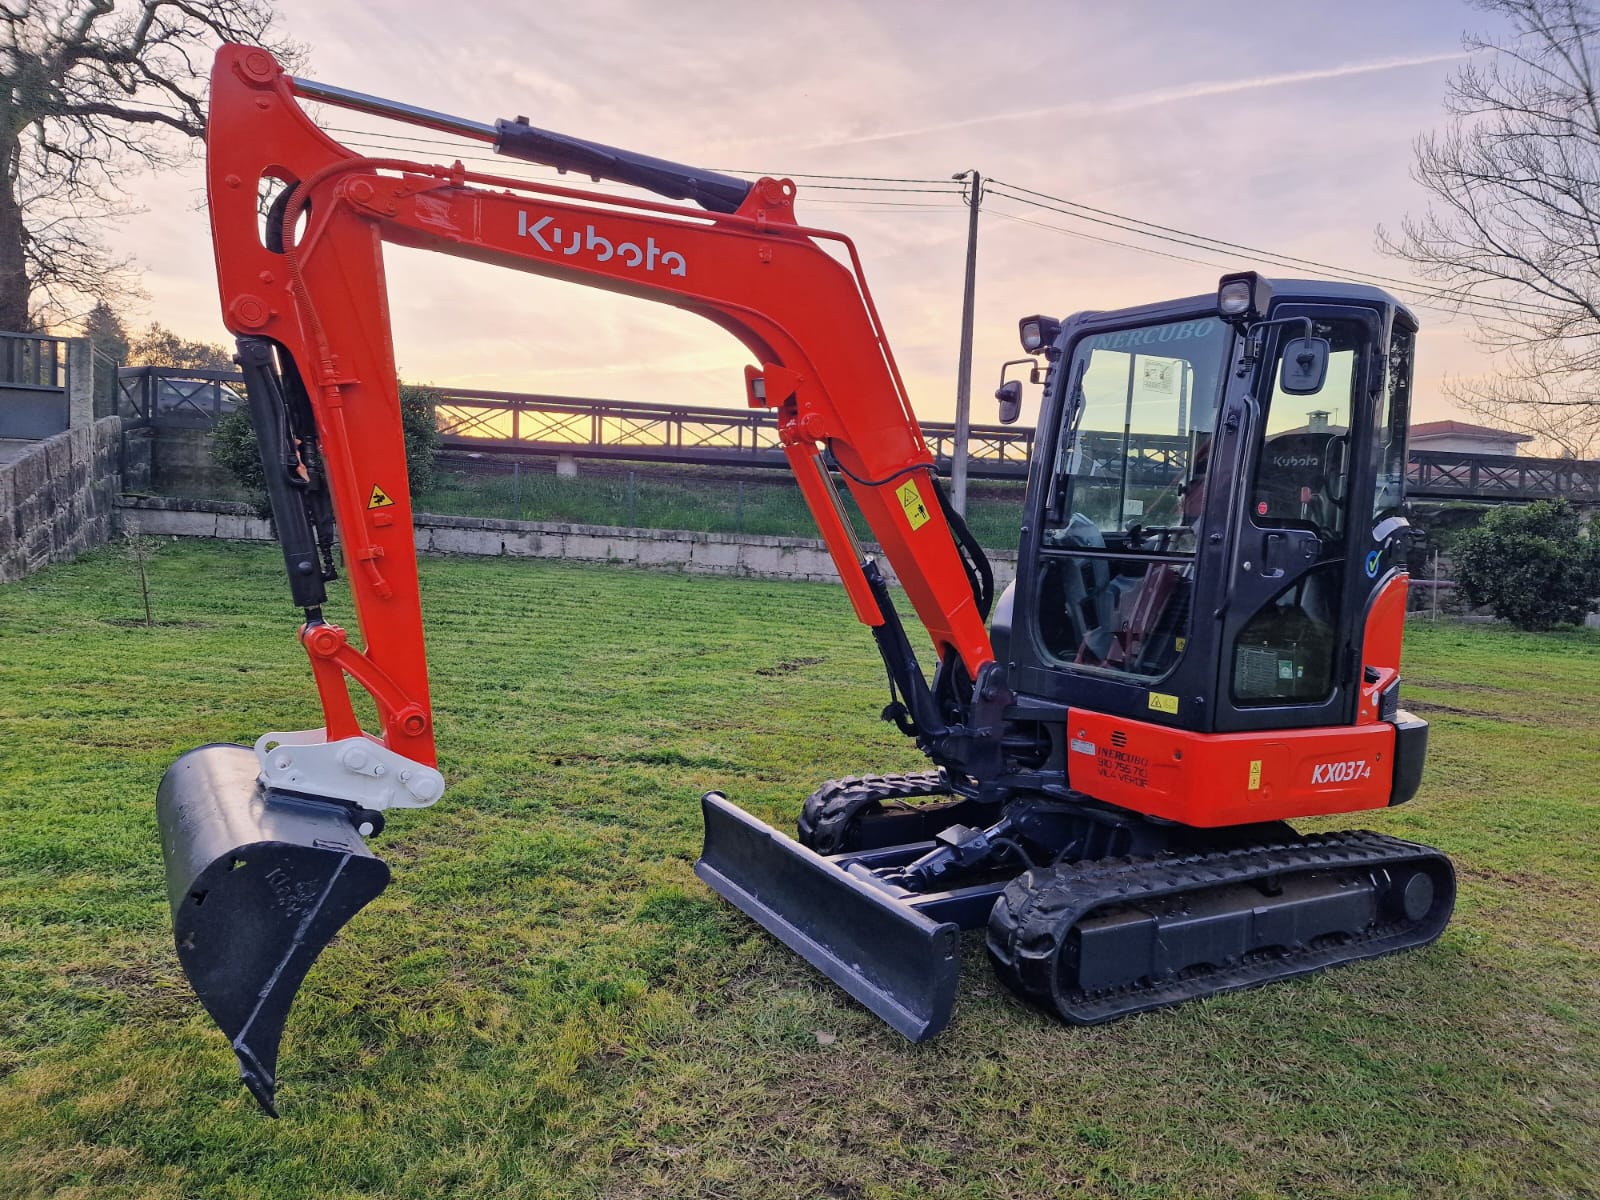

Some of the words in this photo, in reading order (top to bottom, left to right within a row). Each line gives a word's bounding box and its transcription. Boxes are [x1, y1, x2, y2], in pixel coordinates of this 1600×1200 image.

[518, 210, 687, 277] Kubota
[1272, 455, 1319, 467] Kubota
[1311, 760, 1371, 785] KX037-4
